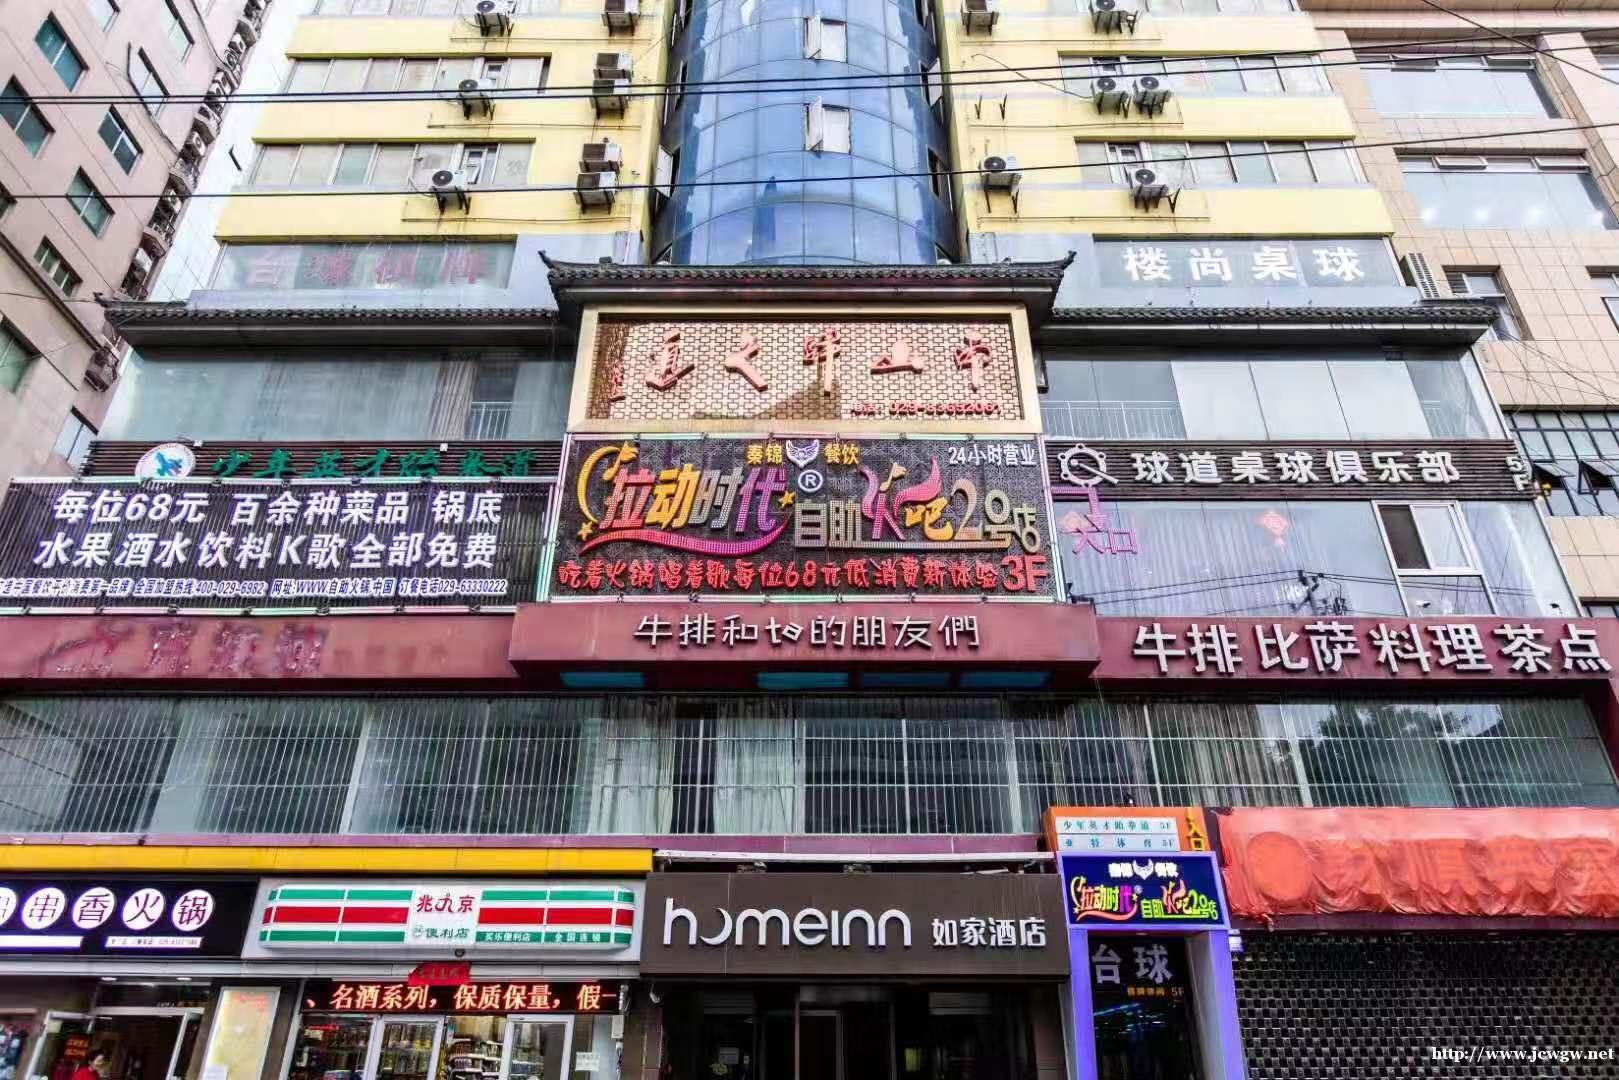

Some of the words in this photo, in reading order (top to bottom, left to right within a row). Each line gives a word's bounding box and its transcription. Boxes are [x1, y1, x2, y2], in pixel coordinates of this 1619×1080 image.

[1121, 246, 1366, 282] 楼尚桌球
[747, 443, 783, 465] 秦锦
[824, 443, 859, 465] 餐饮
[948, 444, 1037, 467] 24小时营业
[1131, 451, 1460, 484] 球道桌球俱乐部
[54, 489, 209, 523] 每位68元
[230, 490, 409, 526] 百余种菜品
[431, 490, 504, 525] 锅底
[599, 463, 787, 535] 拉动时代
[33, 532, 497, 570] 水果酒水饮料K歌全部免费
[1001, 554, 1047, 592] 3F
[1133, 620, 1612, 674] 牛排比萨料理茶点
[931, 916, 1047, 947] 如家酒店
[1091, 943, 1174, 984] 台球
